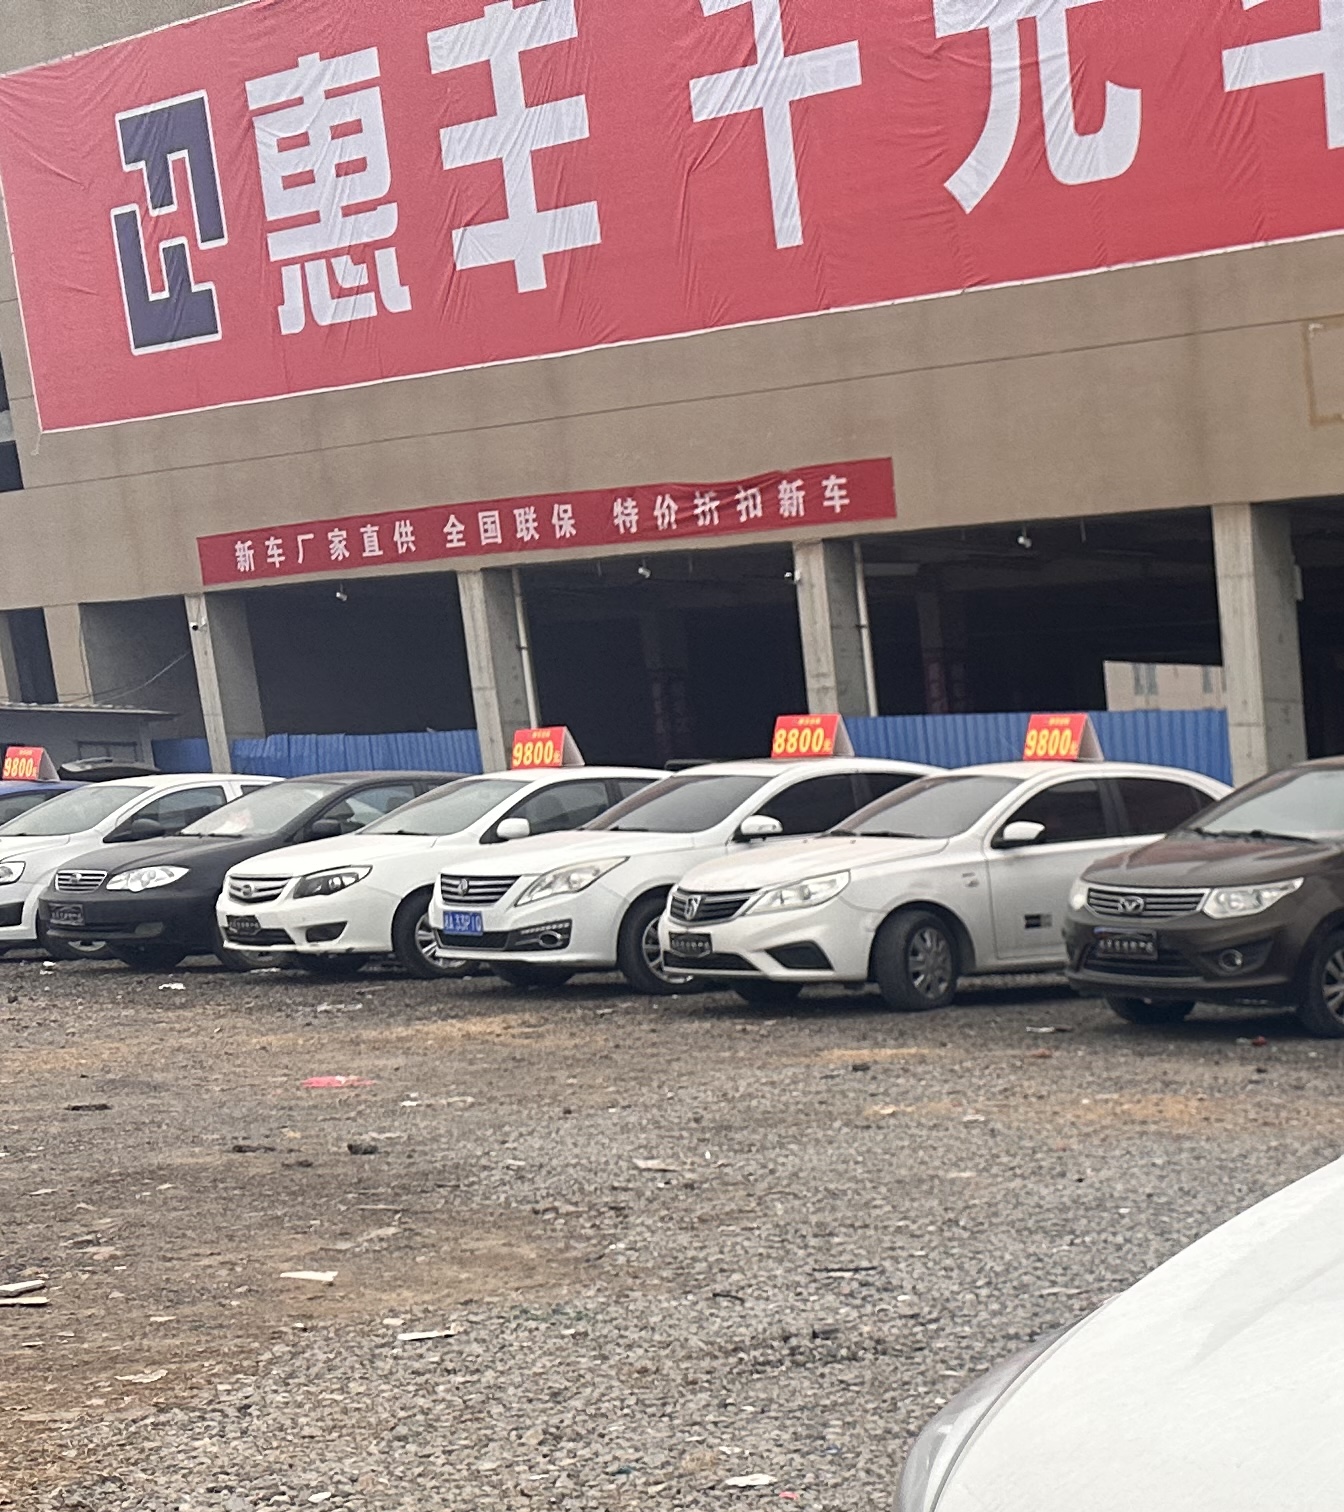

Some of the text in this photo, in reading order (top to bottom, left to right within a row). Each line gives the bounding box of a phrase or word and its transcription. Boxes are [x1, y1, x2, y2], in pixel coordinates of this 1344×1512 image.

[234, 474, 850, 574] 新车厂家直供 全国联保 特价折扣新车
